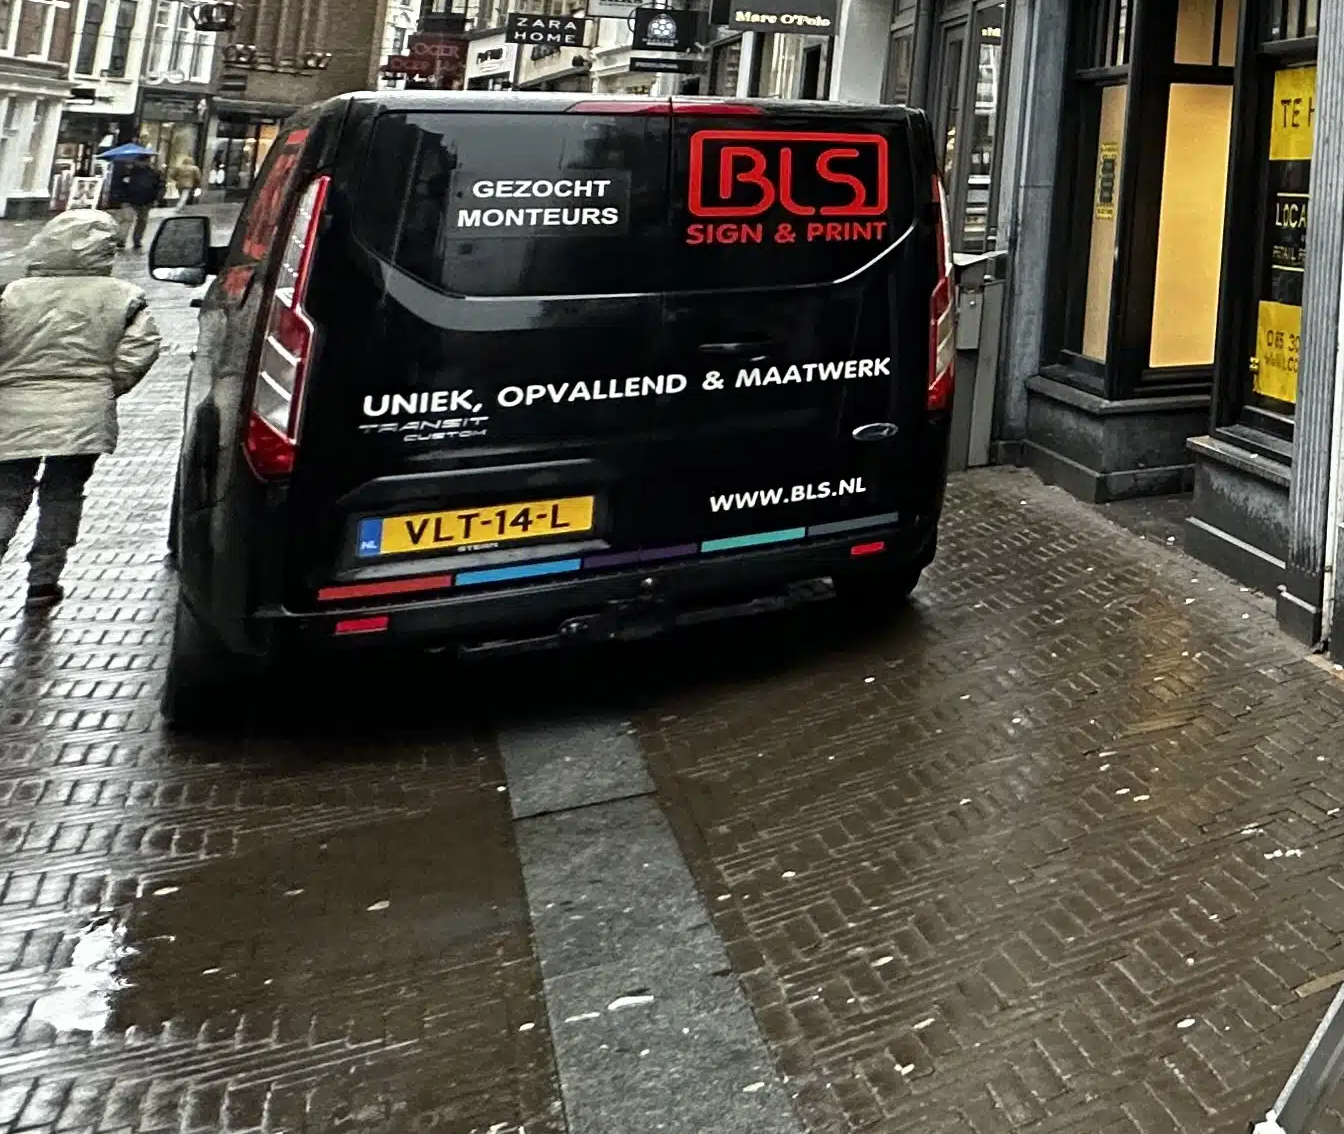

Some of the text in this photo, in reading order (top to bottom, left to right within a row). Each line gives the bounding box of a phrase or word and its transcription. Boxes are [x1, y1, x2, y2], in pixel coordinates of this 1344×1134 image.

[517, 17, 577, 31] ZARA
[735, 10, 832, 27] Marc O'Polo
[514, 31, 576, 44] HOME
[1281, 98, 1302, 128] TE
[472, 180, 611, 198] GEZOCHT
[720, 146, 867, 216] BLS
[457, 207, 618, 228] MONTEURS
[686, 222, 887, 245] SIGN & PRINT
[363, 357, 891, 417] UNIEK, OPVALLEND & MAATWERK
[358, 416, 489, 434] TRANSIT
[403, 429, 488, 442] CUSTOM
[710, 477, 867, 512] WWW.BLS.NL
[361, 503, 570, 550] NL VLT-14-L
